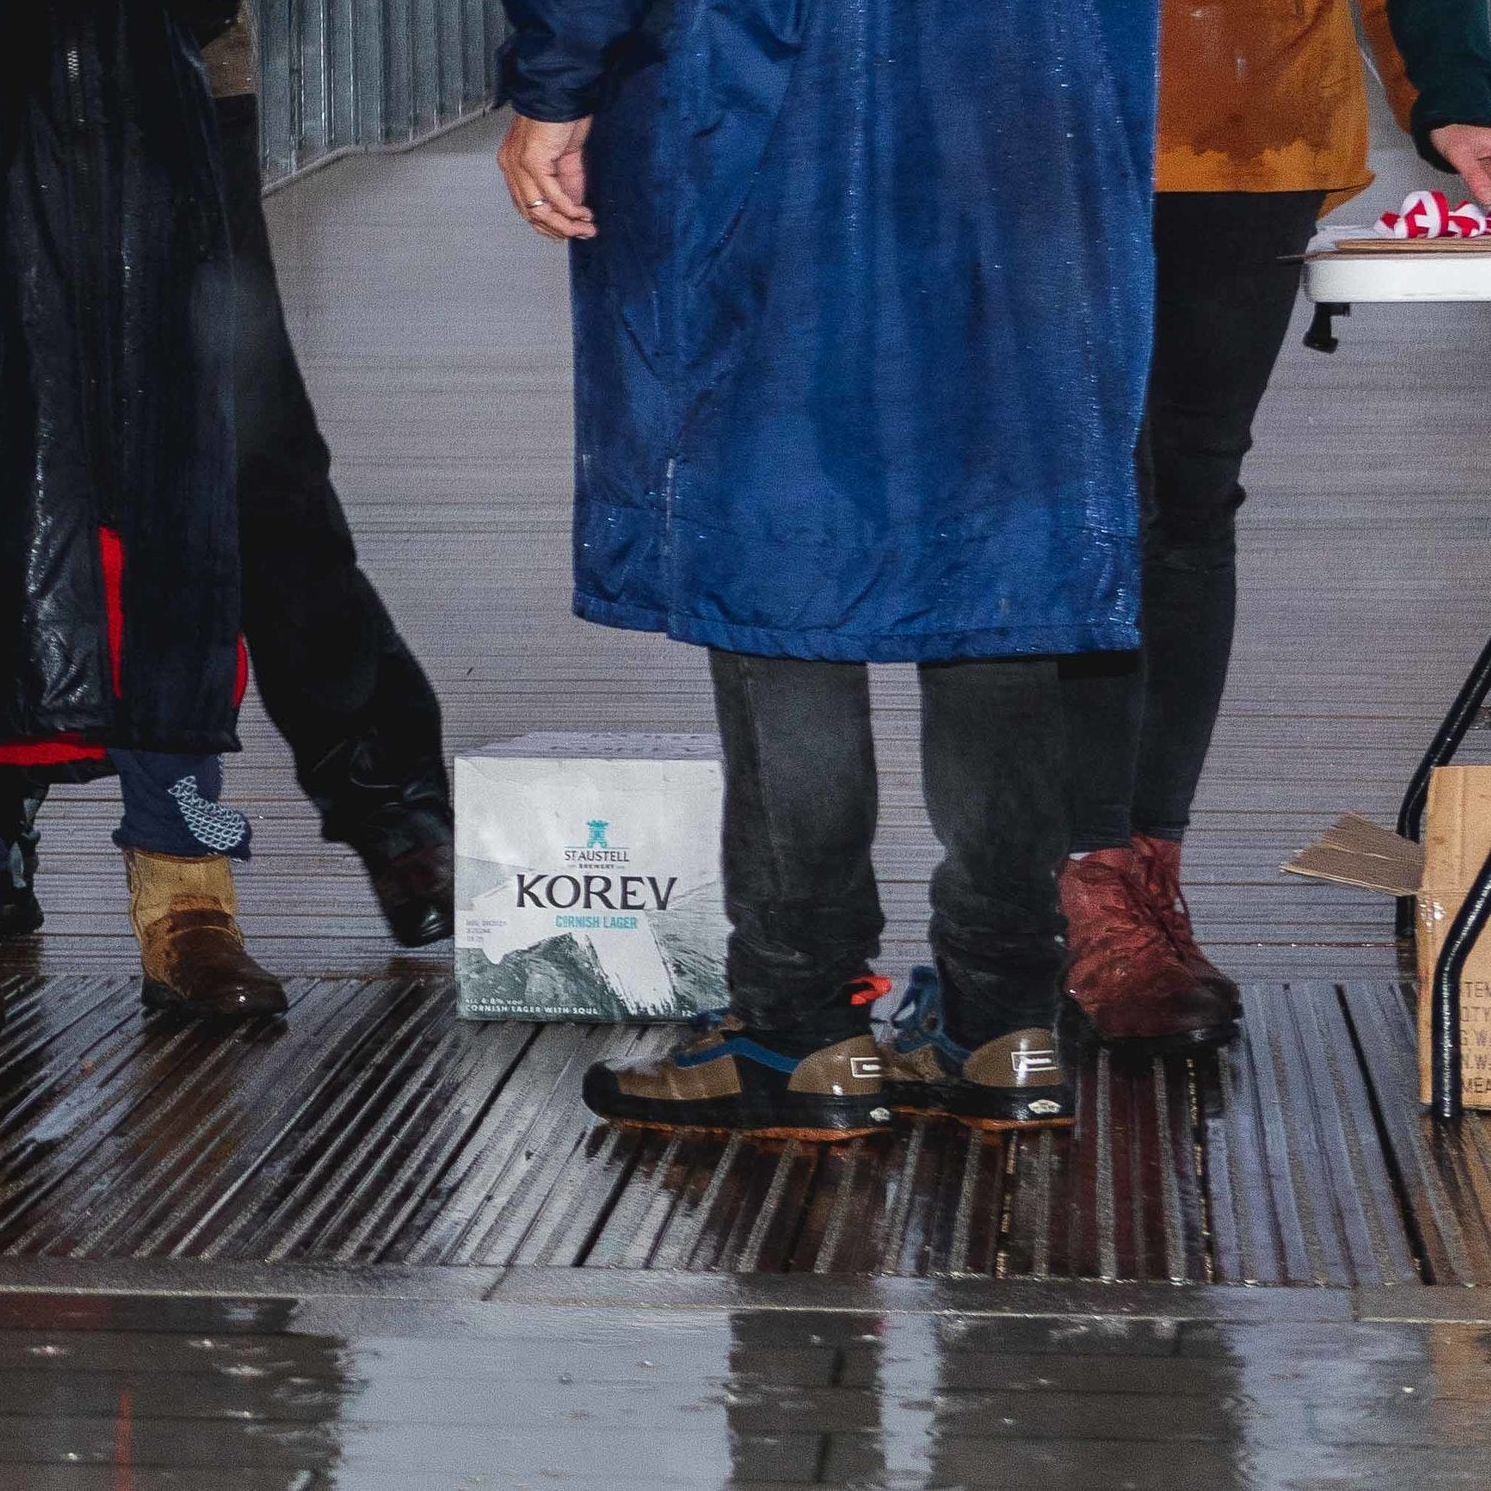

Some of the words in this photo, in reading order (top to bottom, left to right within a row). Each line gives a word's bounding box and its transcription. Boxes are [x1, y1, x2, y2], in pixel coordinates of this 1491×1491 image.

[578, 851, 630, 862] AUSTELL
[516, 873, 678, 911] KOREV
[555, 914, 600, 928] CORNISH
[603, 915, 637, 929] LAGER
